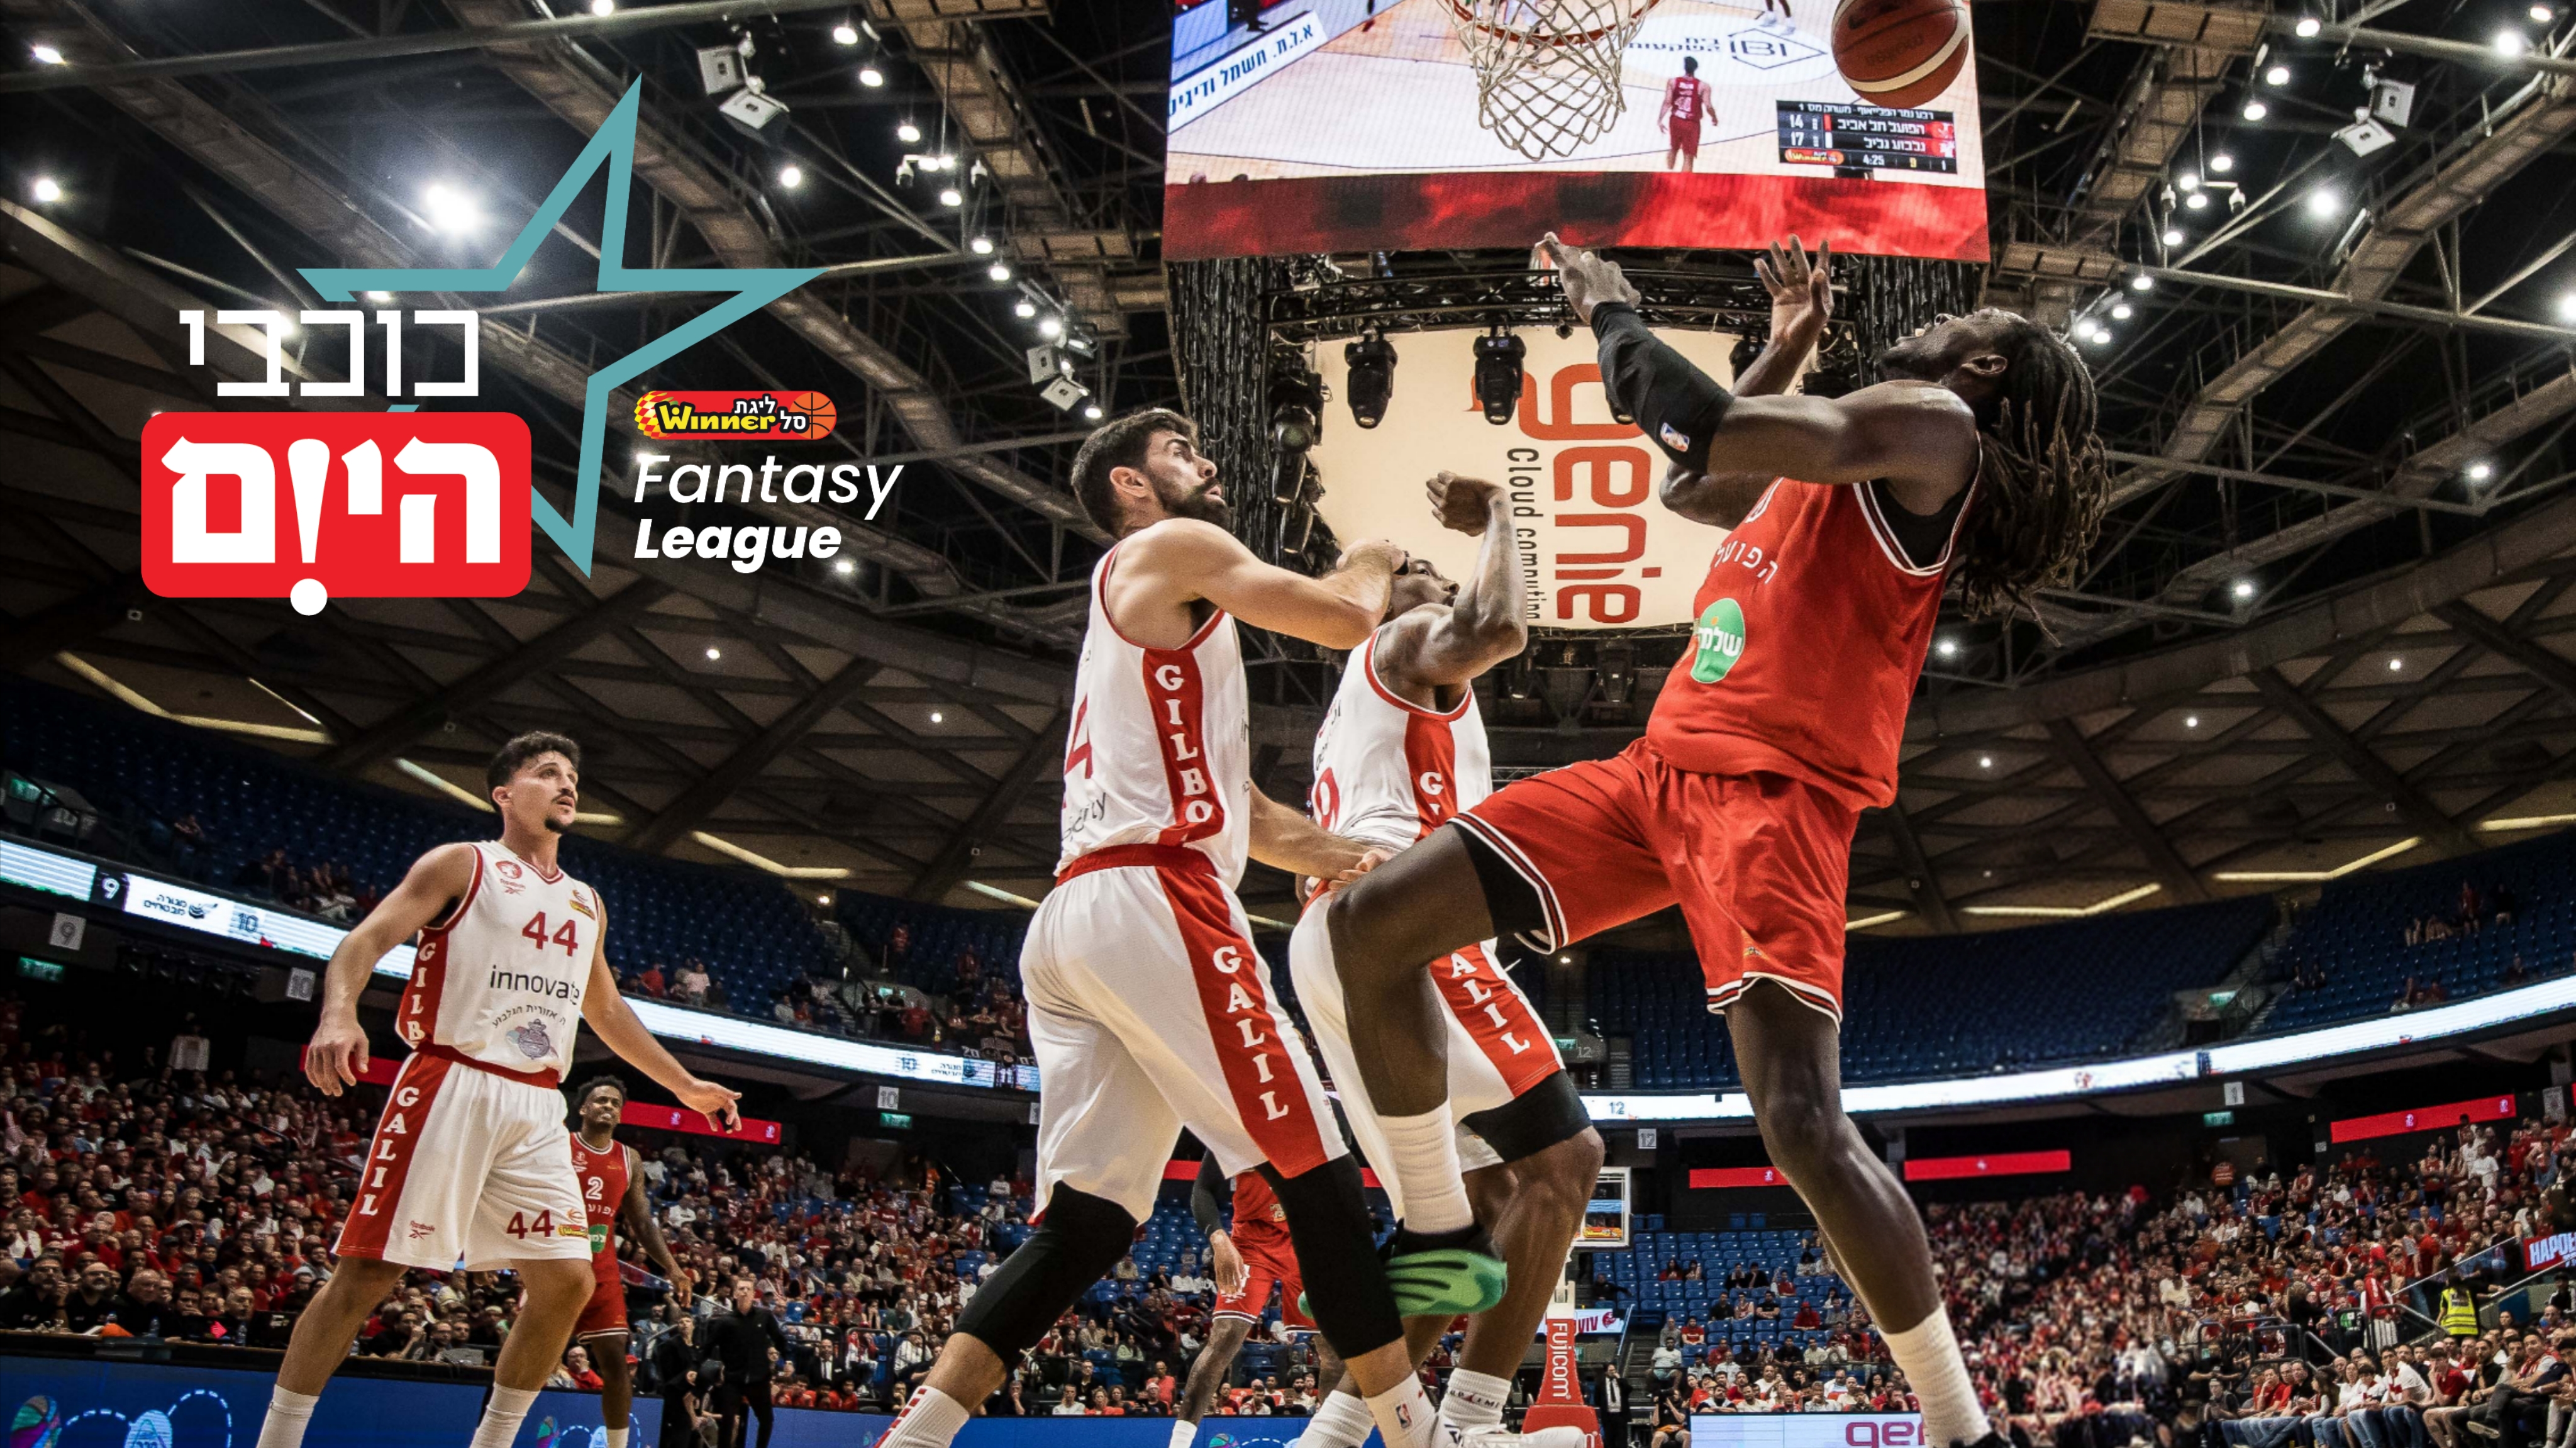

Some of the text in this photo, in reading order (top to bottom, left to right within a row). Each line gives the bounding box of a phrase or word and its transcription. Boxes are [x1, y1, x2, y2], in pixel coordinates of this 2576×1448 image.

[1220, 49, 1267, 86] חשמל
[1790, 114, 1804, 128] 14
[1838, 118, 1925, 135] הפועל תל אביב
[1791, 131, 1804, 146] 17
[1864, 136, 1926, 152] גלבוע גליל
[1863, 154, 1885, 166] 4:25
[1464, 363, 1662, 623] genie
[1714, 540, 1779, 584] הפועל
[103, 877, 120, 899] 9
[522, 911, 579, 957] 44
[492, 1005, 558, 1028] אזורית הגלבוע
[1213, 945, 1289, 1121] GALIL
[1609, 1101, 1625, 1115] 12
[359, 1086, 419, 1216] GALIL
[586, 1176, 604, 1200] 2
[506, 1210, 555, 1239] 44
[1846, 1422, 1926, 1448] ge
